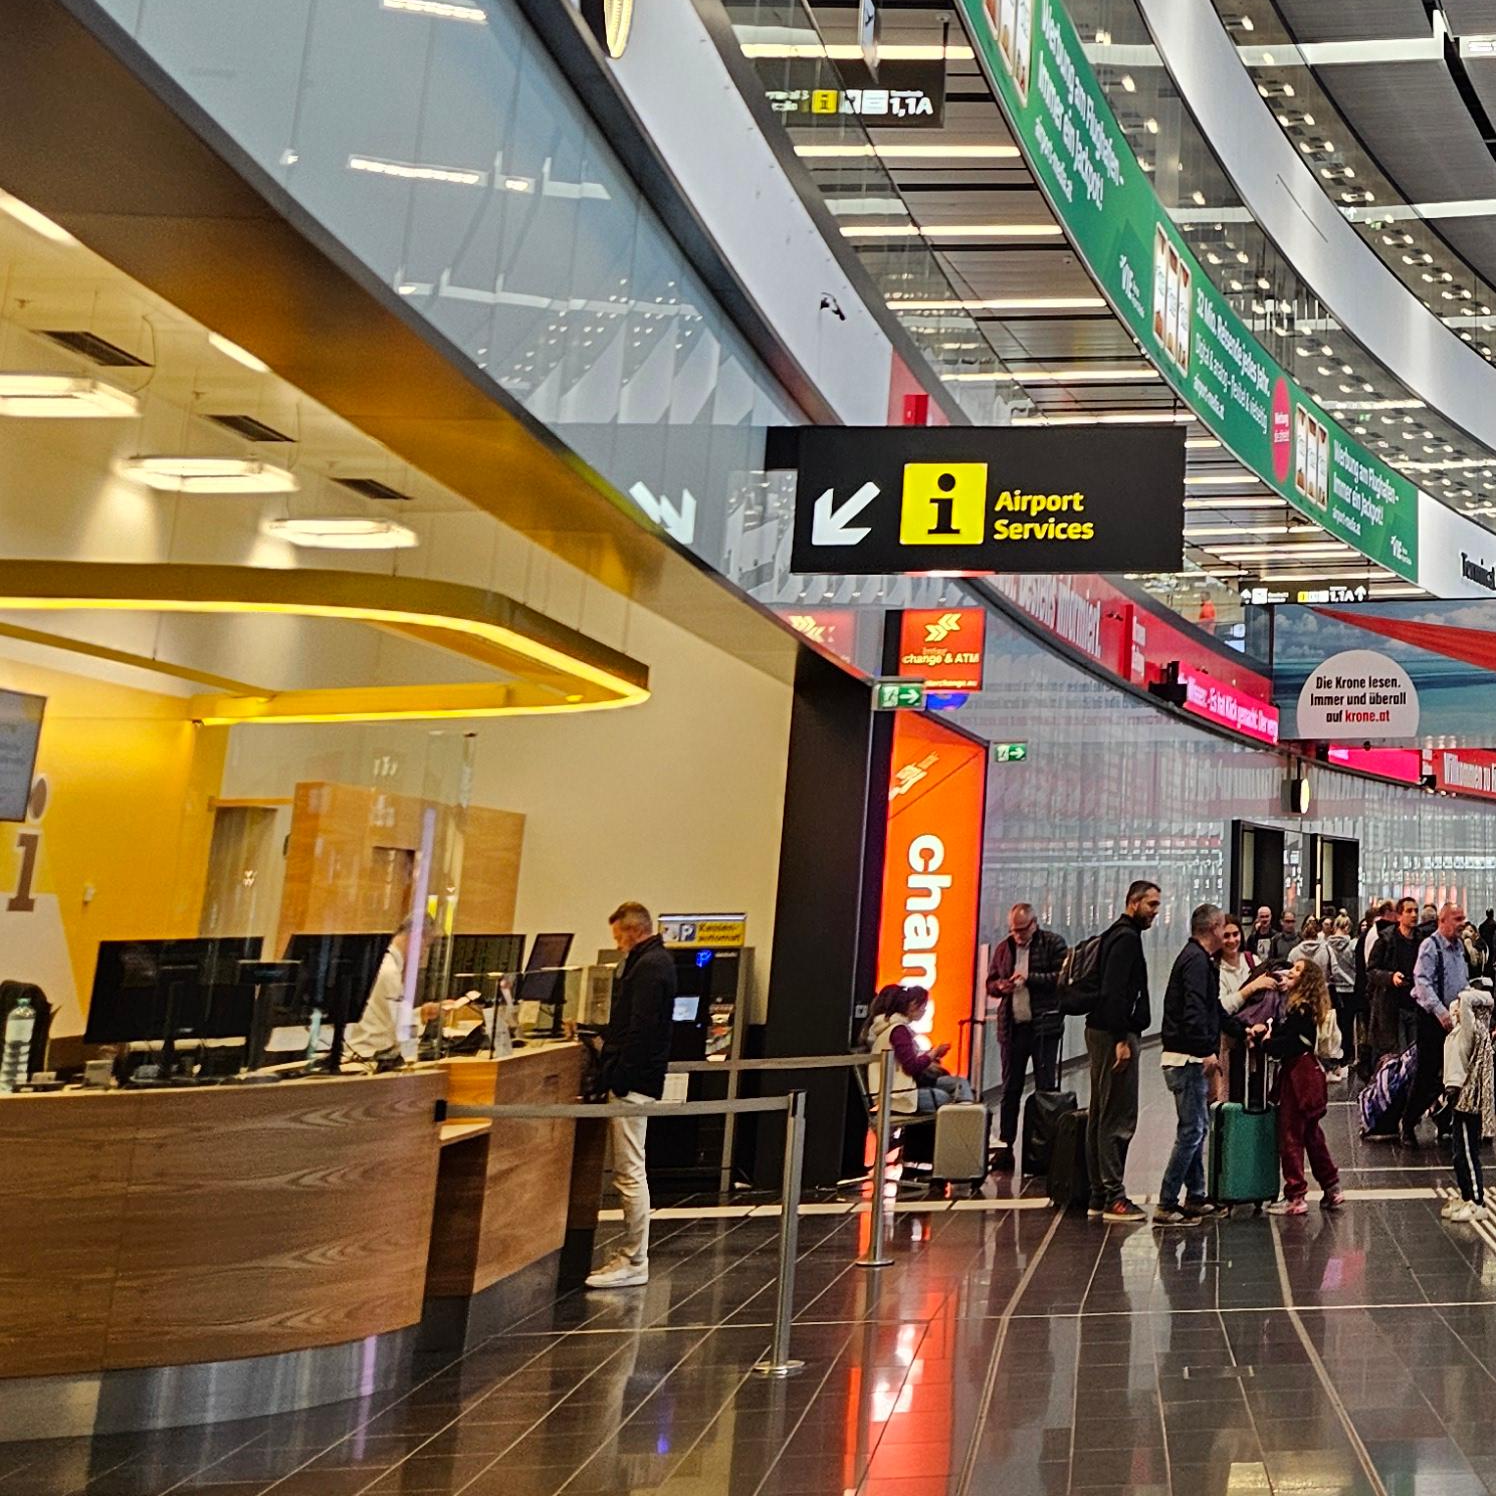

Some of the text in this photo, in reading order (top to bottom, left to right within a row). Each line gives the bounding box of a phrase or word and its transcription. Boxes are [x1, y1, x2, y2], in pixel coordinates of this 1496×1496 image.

[994, 489, 1084, 517] Airport
[993, 517, 1094, 540] Services
[902, 653, 980, 666] change & ATM
[1316, 676, 1400, 689] Die Krone lesen.
[1310, 692, 1406, 706] Immer und überall
[1326, 710, 1390, 722] auf krone.at
